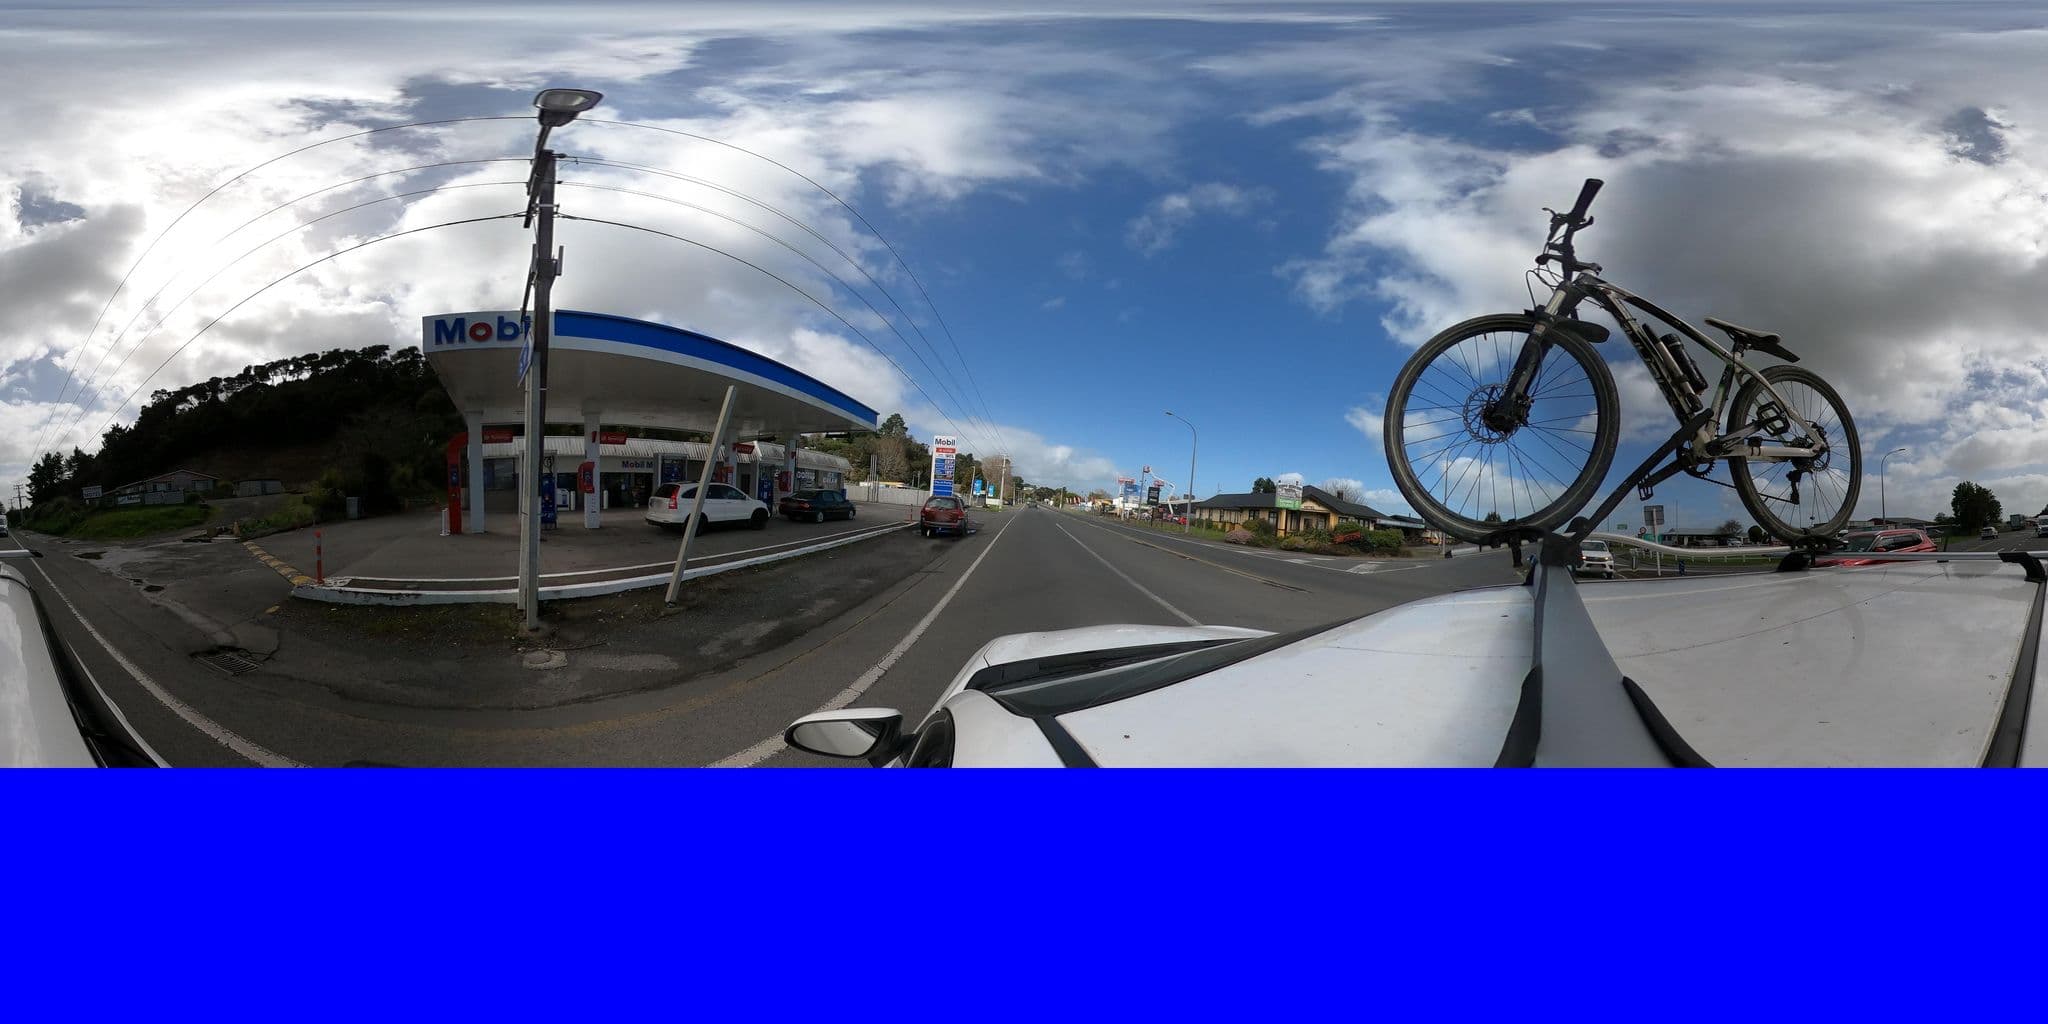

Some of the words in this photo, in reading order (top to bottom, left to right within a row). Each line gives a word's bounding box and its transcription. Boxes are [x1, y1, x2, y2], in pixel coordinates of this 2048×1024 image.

[435, 315, 531, 345] Mobi
[934, 438, 956, 446] Mobil
[622, 460, 645, 469] Mobil
